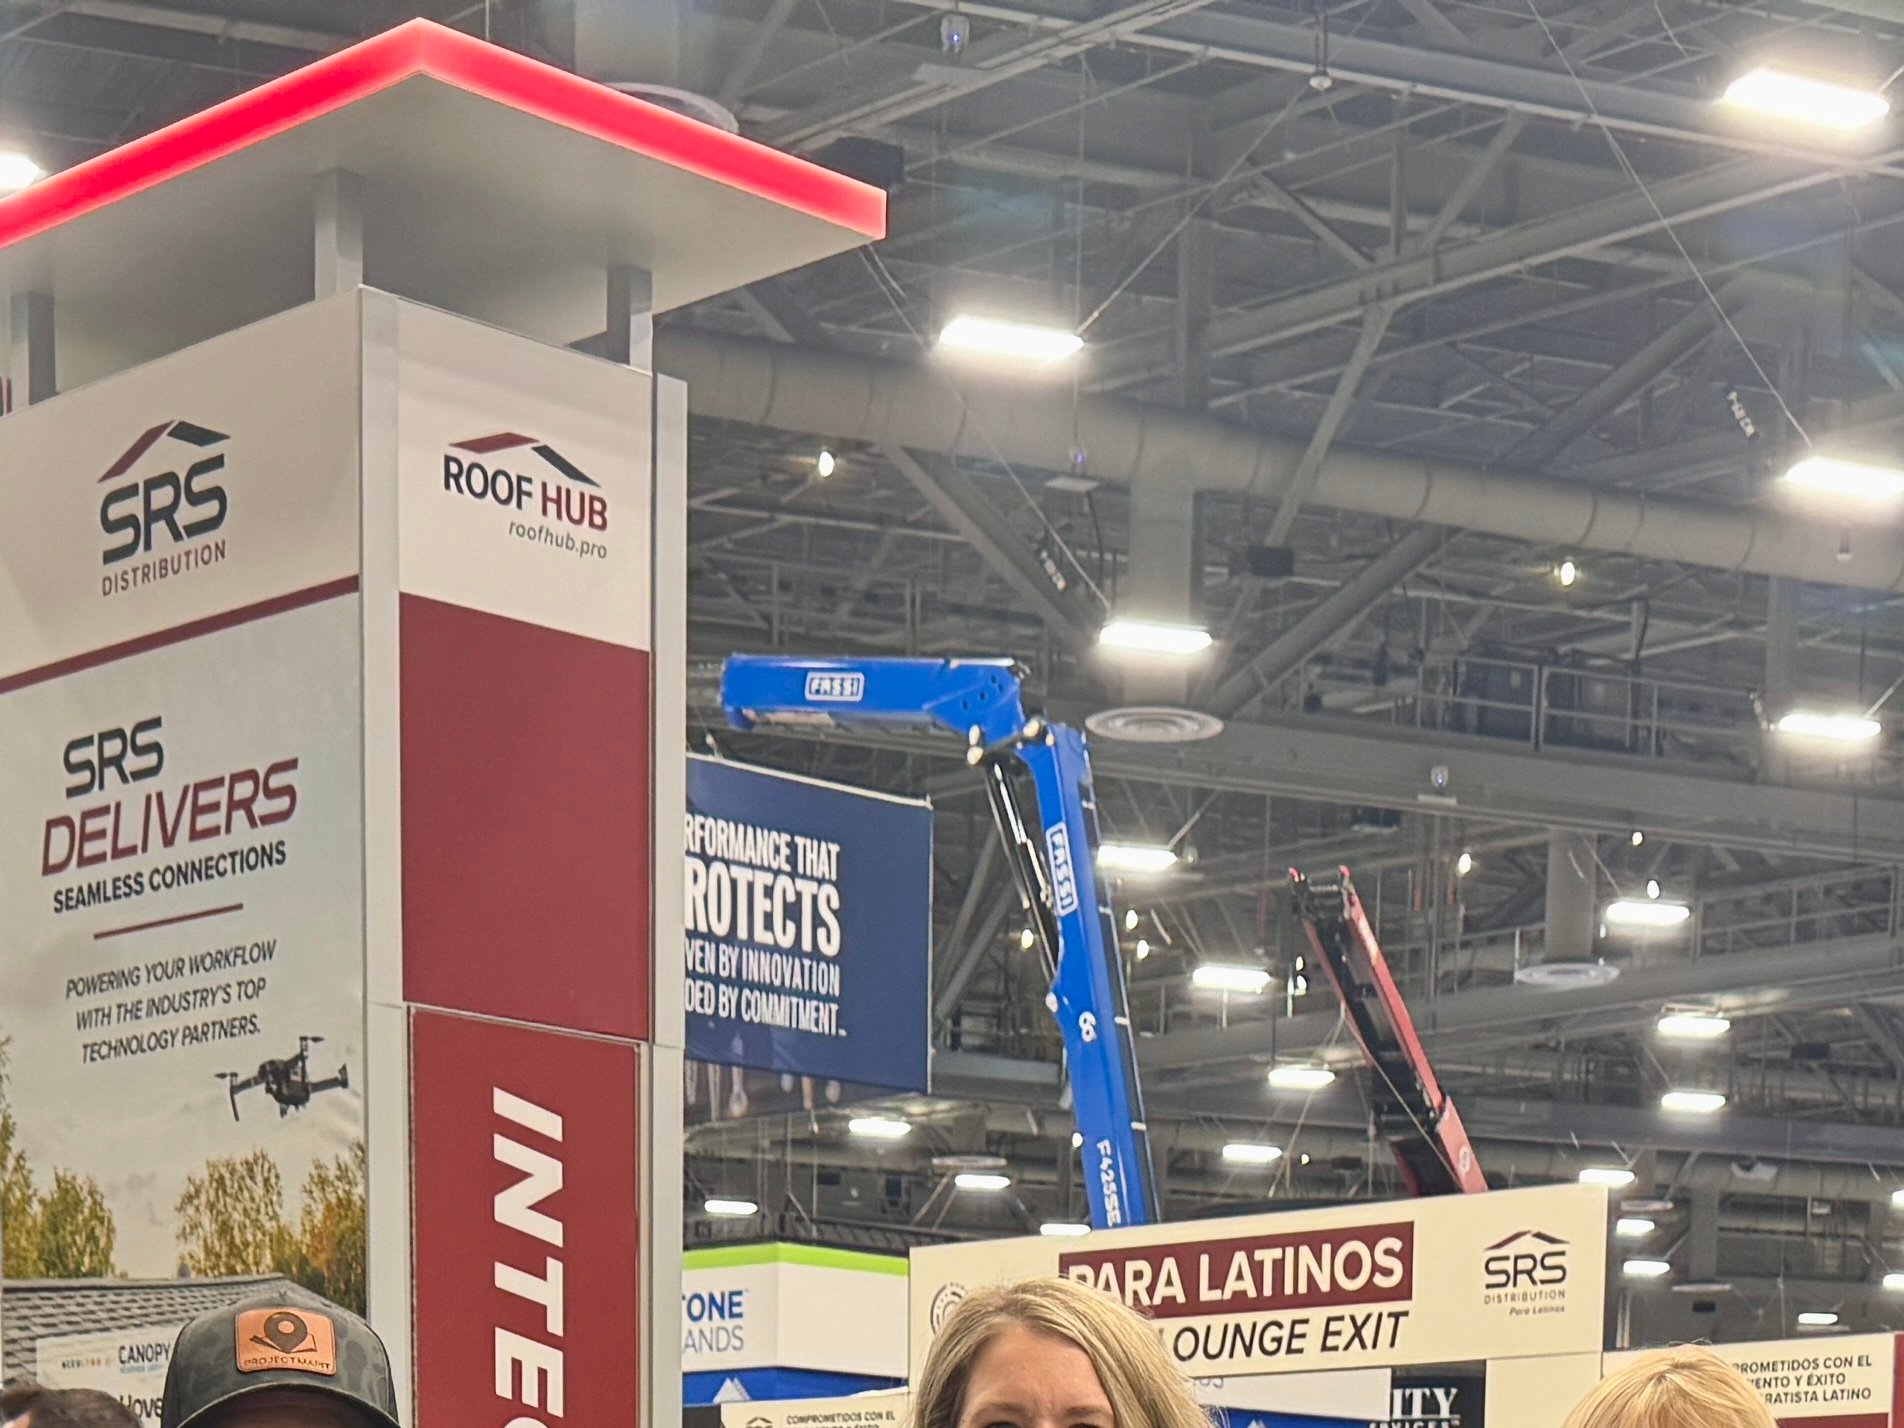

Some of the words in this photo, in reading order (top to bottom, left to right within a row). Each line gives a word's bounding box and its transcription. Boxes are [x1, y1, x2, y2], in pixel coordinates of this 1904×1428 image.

[100, 453, 227, 564] SRS
[443, 453, 534, 517] ROOF
[541, 483, 607, 531] HUB
[508, 517, 607, 559] roofhub.pro
[101, 541, 227, 597] DISTRIBUTION
[809, 677, 859, 696] FASSI
[63, 716, 163, 798] SRS
[41, 758, 298, 876] DELIVERS
[52, 870, 145, 914] SEAMLESS
[149, 841, 287, 892] CONNECTIONS
[795, 838, 840, 881] THAT
[1050, 830, 1074, 910] FASSI
[66, 969, 140, 1000] POWERING
[143, 959, 185, 988] YOUR
[188, 939, 276, 976] WORKFLOW
[719, 945, 739, 977] BY
[742, 948, 840, 996] INNOVATION
[76, 1003, 112, 1031] WITH
[115, 999, 143, 1024] THE
[146, 981, 232, 1019] INDUSTRY'S
[235, 976, 266, 1001] TOP
[719, 984, 738, 1017] BY
[82, 1028, 177, 1064] TECHNOLOGY
[182, 1012, 260, 1047] PARTNERS.
[1070, 1256, 1185, 1305] PARA
[1199, 1237, 1404, 1302] LATINOS
[1483, 1251, 1567, 1288] SRS
[1483, 1289, 1566, 1305] DISTRIBUTION
[1509, 1305, 1540, 1317] Para
[119, 1341, 171, 1363] CANOPY
[1320, 1311, 1408, 1351] EXIT
[1795, 1374, 1803, 1386] Y
[1807, 1370, 1846, 1386] ÉXITO
[1823, 1357, 1852, 1369] CON
[1858, 1355, 1872, 1366] EL
[1392, 1388, 1457, 1419] ITY
[1823, 1387, 1871, 1401] LATINO
[864, 1412, 883, 1421] CON
